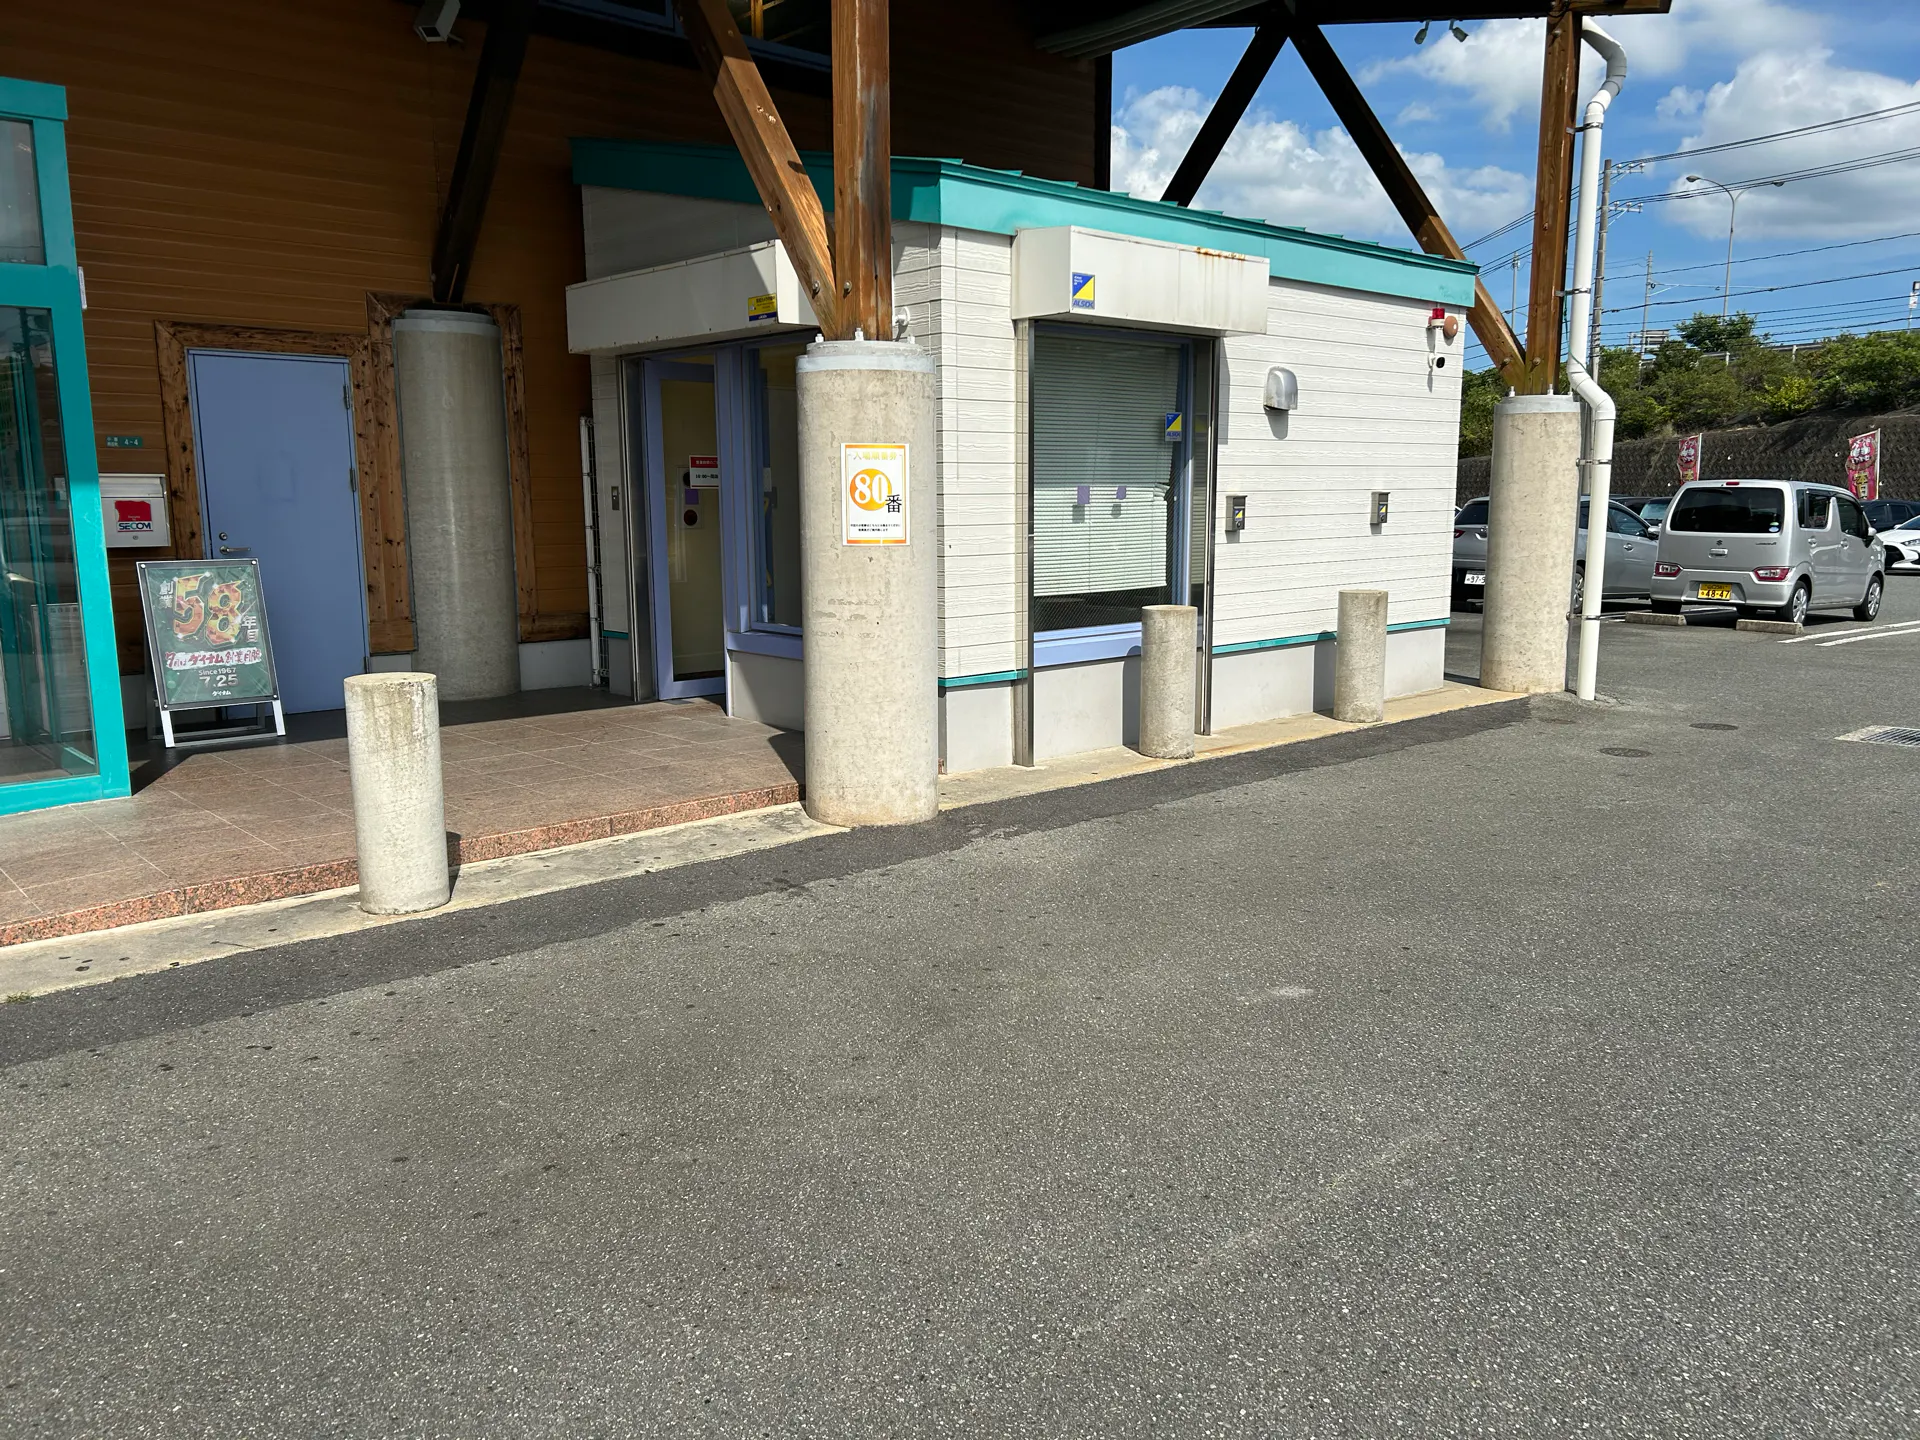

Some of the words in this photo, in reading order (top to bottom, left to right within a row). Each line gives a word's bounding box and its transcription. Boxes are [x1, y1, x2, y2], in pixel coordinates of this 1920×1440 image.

[118, 522, 152, 530] SECOM
[159, 580, 174, 608] 創業
[174, 572, 245, 645] 58
[241, 615, 260, 643] 年目
[199, 674, 239, 687] 7.25
